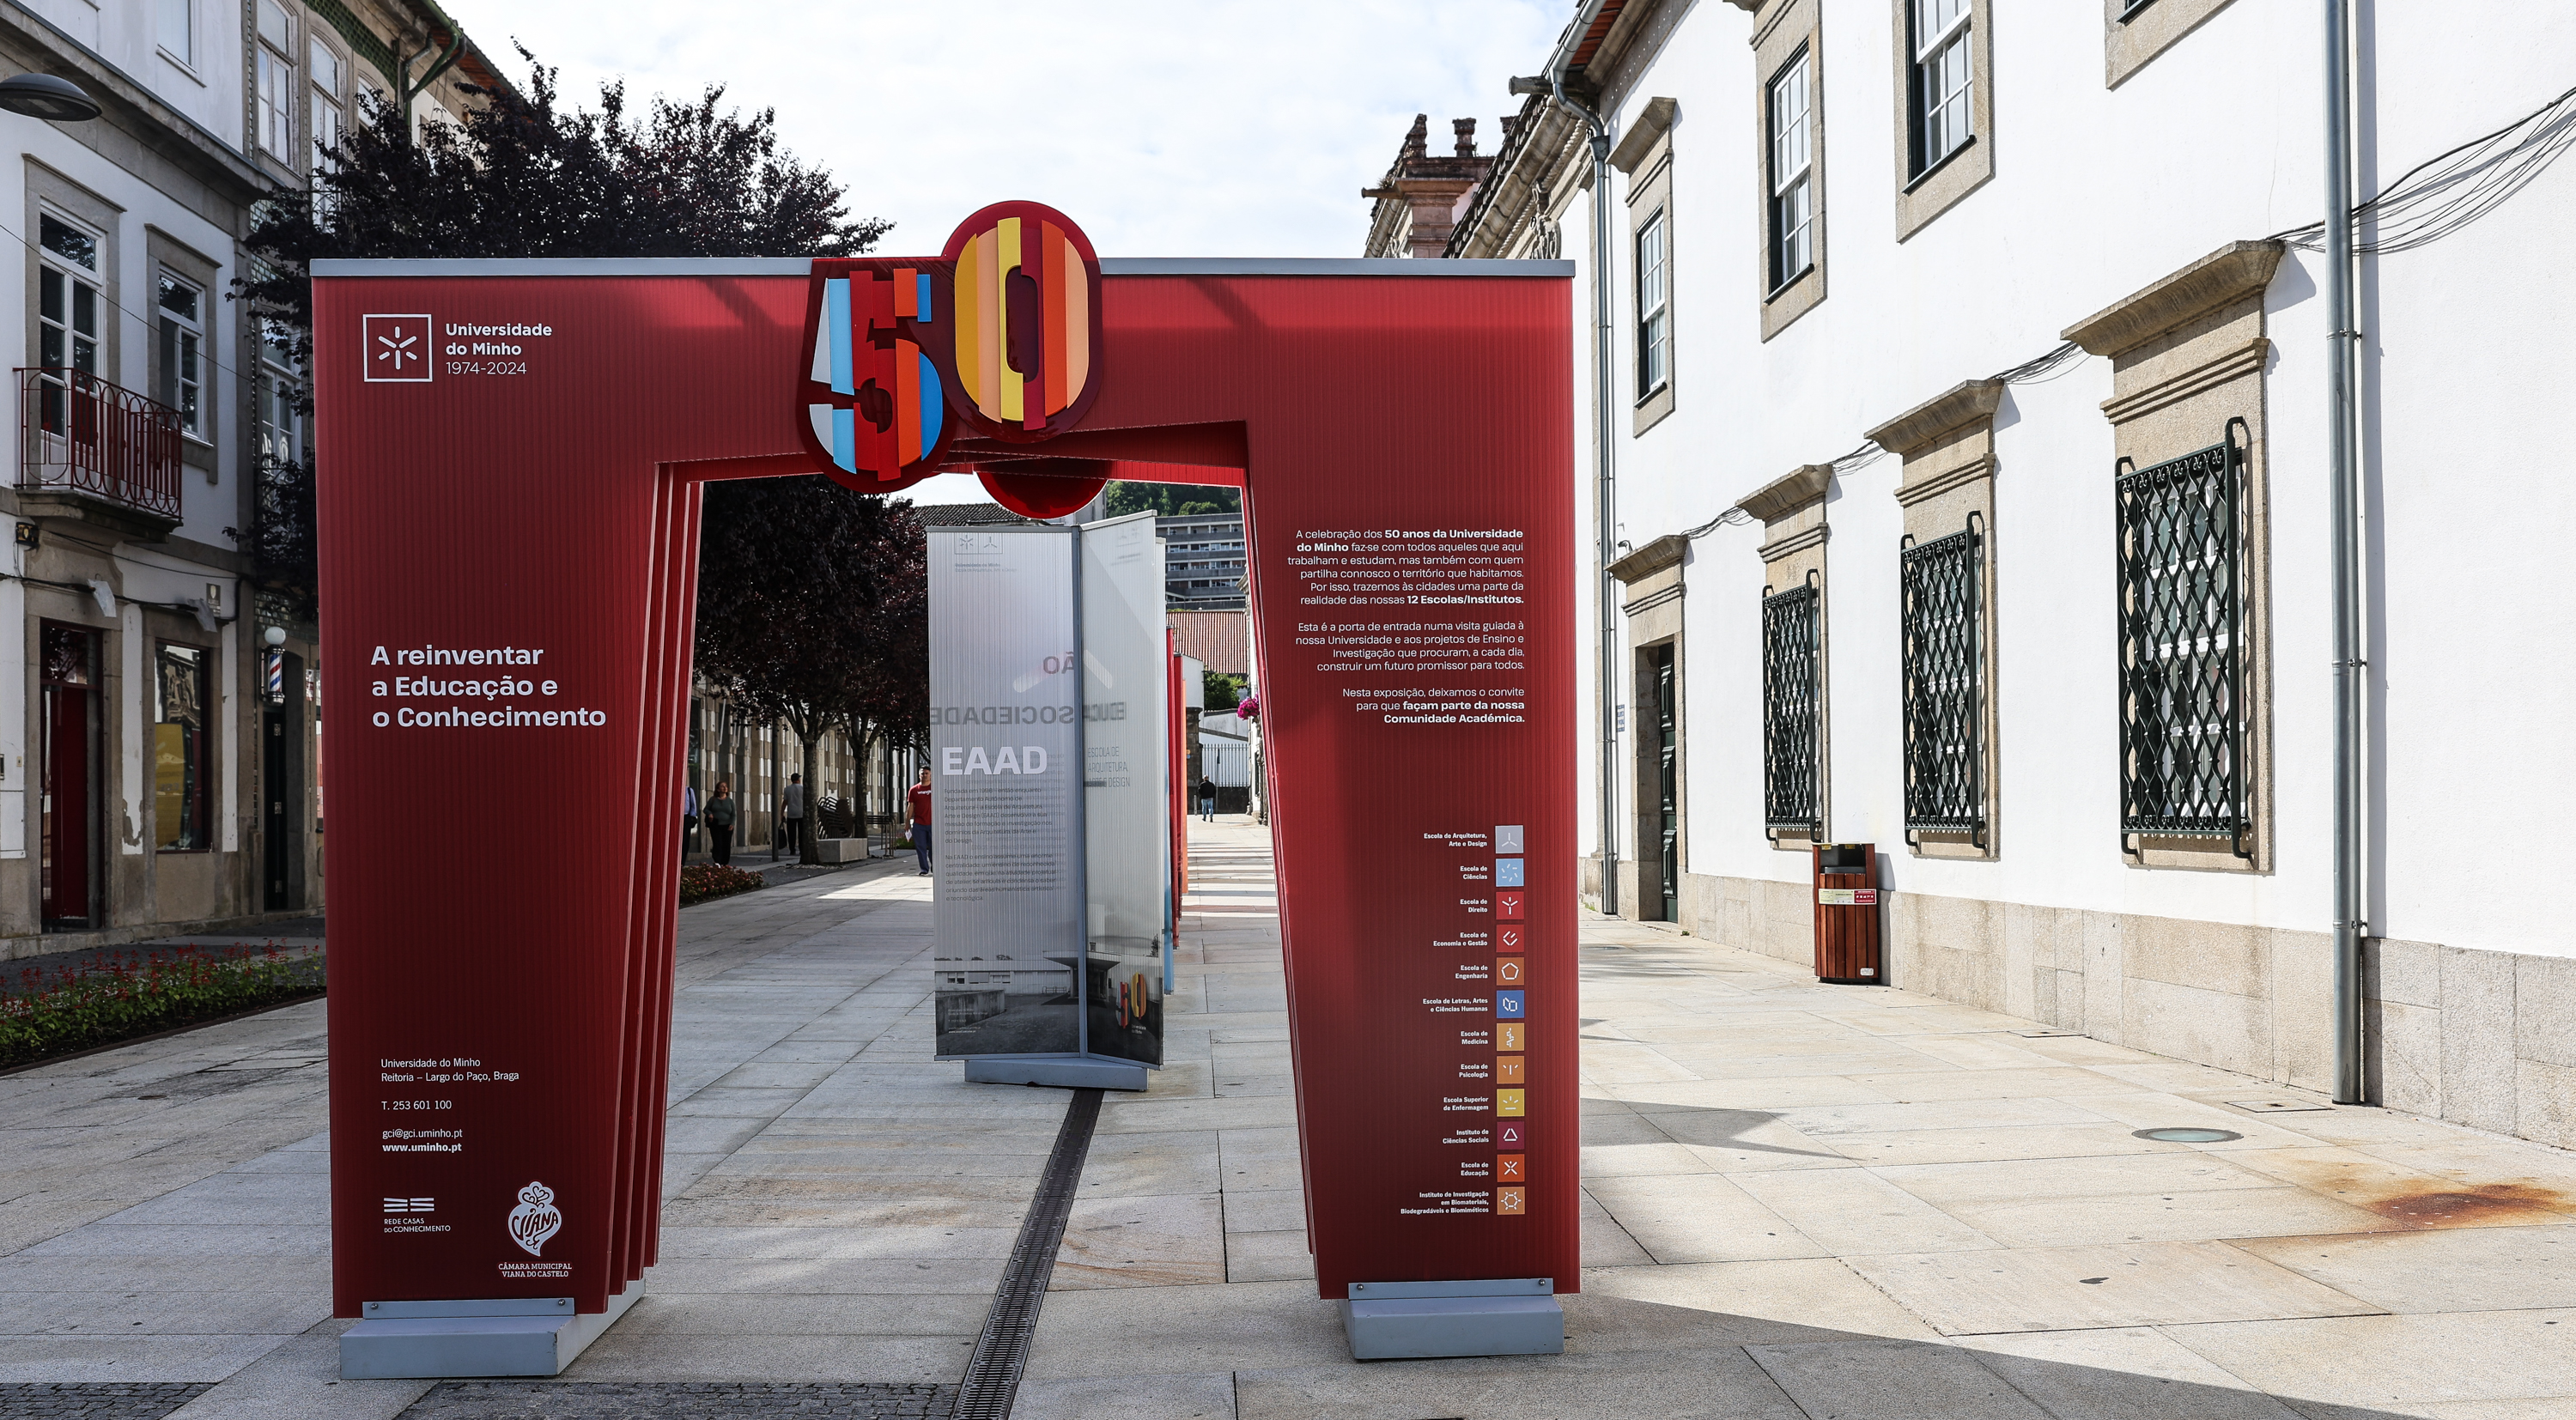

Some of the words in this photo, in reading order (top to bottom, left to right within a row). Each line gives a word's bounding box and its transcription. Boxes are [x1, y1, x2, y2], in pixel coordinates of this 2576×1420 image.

[446, 323, 552, 336] Universidade
[446, 343, 467, 355] do
[473, 343, 521, 355] Minho
[809, 217, 1090, 481] 50
[446, 361, 526, 374] 1974-2024
[1296, 530, 1303, 538] A
[1305, 530, 1361, 540] celebração
[1364, 530, 1382, 538] dos
[1385, 530, 1400, 538] 50
[1432, 529, 1447, 538] da
[1449, 529, 1523, 538] Universidade
[1297, 543, 1312, 552] do
[1315, 543, 1349, 551] Minho
[1352, 543, 1379, 551] faz-se
[1407, 543, 1436, 551] todos
[1438, 543, 1478, 553] aqueles
[1480, 544, 1499, 553] que
[1502, 543, 1523, 553] aqui
[1287, 555, 1339, 565] trabalham
[1350, 555, 1396, 565] estudam,
[1423, 555, 1466, 564] também
[1494, 557, 1523, 566] quem
[1301, 596, 1346, 604] realidade
[1350, 596, 1367, 604] das
[1407, 595, 1419, 604] 12
[1421, 594, 1524, 604] Escolas/Institutos.
[371, 646, 390, 665] A
[398, 644, 544, 665] reinventar
[372, 681, 387, 696] a
[396, 675, 533, 701] Educação
[541, 680, 557, 695] e
[1343, 689, 1370, 697] Nesta
[1374, 688, 1425, 699] exposição,
[1428, 688, 1477, 697] deixamos
[1488, 687, 1524, 696] convite
[1357, 703, 1378, 712] para
[1381, 703, 1400, 712] que
[1402, 701, 1438, 712] façam
[1441, 701, 1472, 712] parte
[1474, 701, 1488, 709] da
[373, 712, 390, 727] o
[398, 706, 606, 727] Conhecimento
[1384, 714, 1456, 723] Comunidade
[1459, 713, 1525, 723] Académica.
[1088, 747, 1110, 757] ESCOLA
[942, 746, 1048, 775] EAAD
[1109, 777, 1130, 787] DESIGN
[381, 1059, 437, 1068] Universidade
[440, 1059, 451, 1067] do
[453, 1058, 481, 1067] Minho
[381, 1073, 414, 1082] Reitoria
[426, 1072, 450, 1083] Largo
[453, 1072, 464, 1081] do
[466, 1071, 490, 1083] Paço,
[494, 1071, 519, 1082] Braga
[381, 1101, 390, 1110] T.
[393, 1101, 410, 1110] 253
[413, 1101, 430, 1110] 601
[435, 1100, 452, 1109] 100
[382, 1128, 463, 1139] gci@gci.uminho.pt
[382, 1143, 462, 1153] www.uminho.pt
